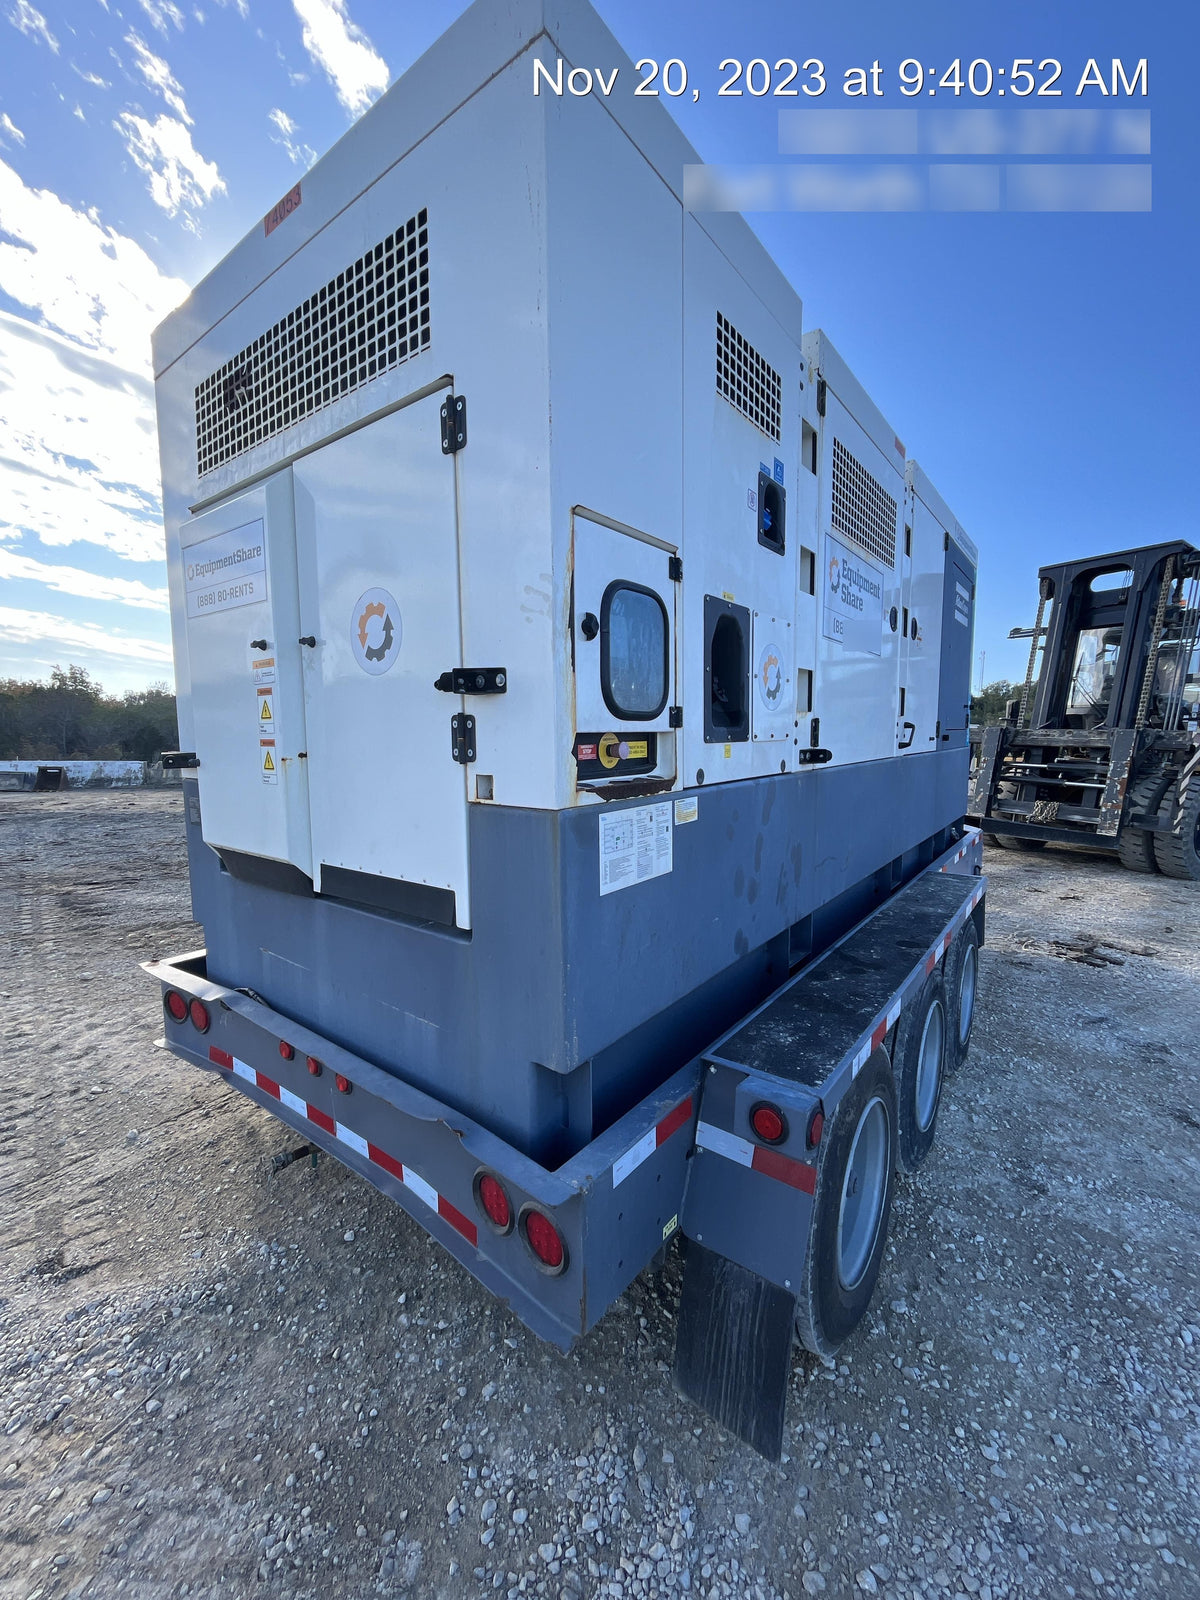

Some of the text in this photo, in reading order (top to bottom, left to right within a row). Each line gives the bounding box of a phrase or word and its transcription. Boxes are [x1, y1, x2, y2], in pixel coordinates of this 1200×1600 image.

[195, 545, 262, 577] EquipmentShare
[842, 558, 881, 600] Equipment
[197, 582, 254, 608] (888) 80-RENTS
[840, 584, 864, 612] Share
